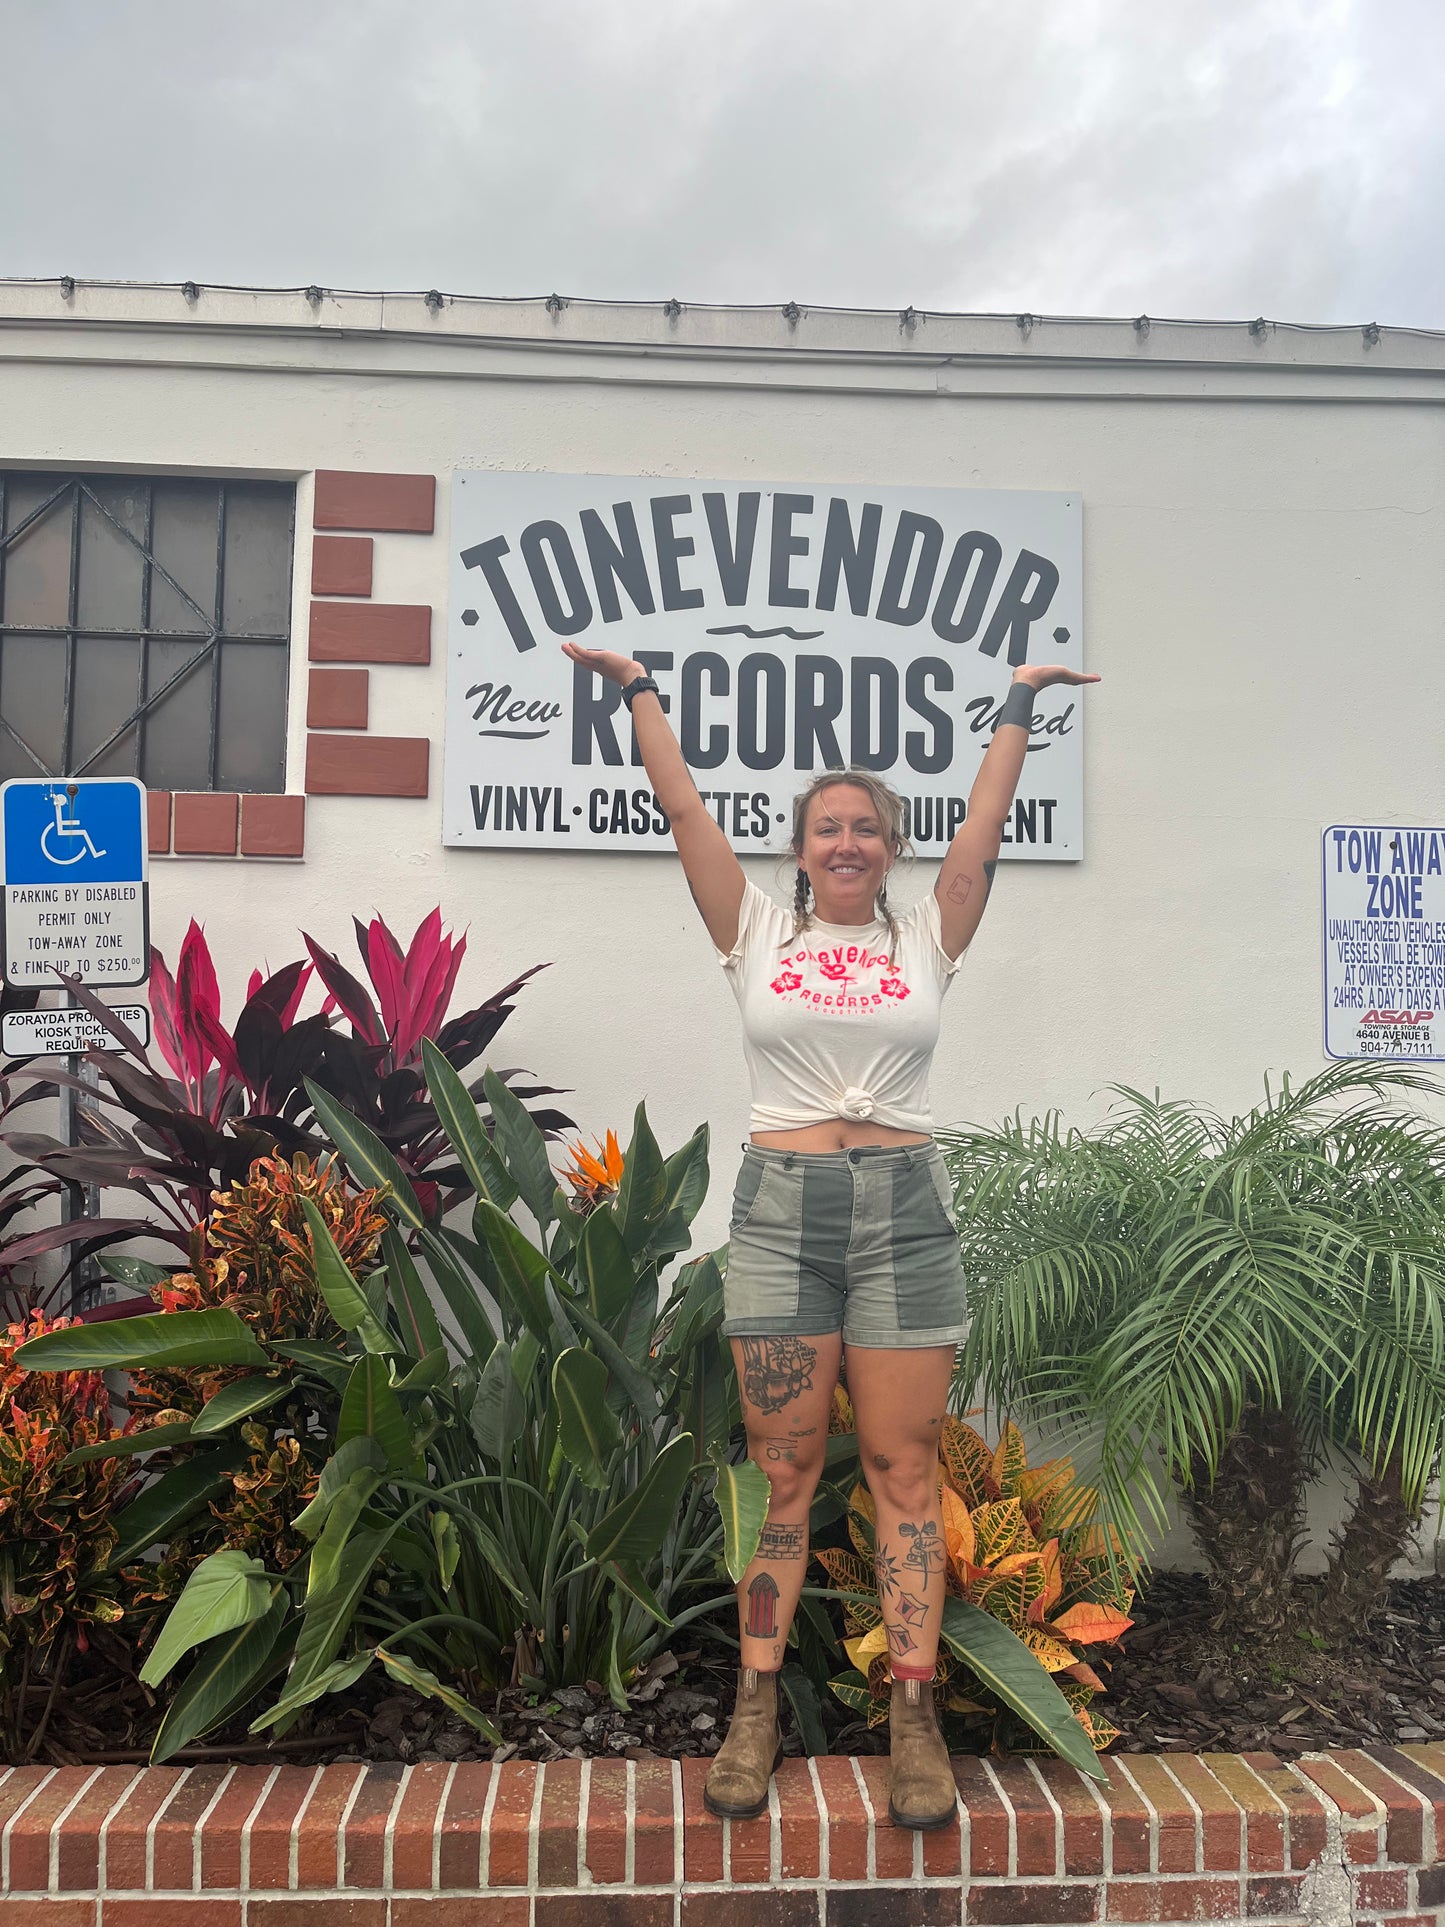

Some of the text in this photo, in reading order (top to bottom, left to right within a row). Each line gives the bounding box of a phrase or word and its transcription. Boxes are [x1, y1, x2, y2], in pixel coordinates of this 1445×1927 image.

[460, 491, 1060, 667] TONEVENDOR
[465, 682, 562, 724] New
[964, 695, 1075, 736] Ued
[469, 785, 570, 833] VINYL
[589, 788, 770, 838] CASSTES
[1333, 830, 1382, 874] TOW
[13, 887, 136, 903] PARKING BY DISABLED
[1366, 875, 1423, 919] ZONE
[39, 911, 111, 926] PERMIT ONLY
[1329, 920, 1401, 942] UNAUTHORIZED
[28, 935, 123, 950] TOW-AWAY ZONE
[1338, 942, 1380, 965] VESSELS
[1382, 943, 1405, 965] WILL
[1407, 944, 1419, 965] BE
[11, 962, 18, 974] &
[25, 961, 49, 974] FINE
[56, 960, 70, 973] UP
[77, 959, 90, 972] TO
[1345, 964, 1356, 986] AT
[1359, 965, 1403, 988] OWNER'S
[1334, 986, 1367, 1009] 24HRS.
[1369, 987, 1376, 1009] A
[1378, 988, 1396, 1009] DAY
[1399, 989, 1404, 1009] 7
[1407, 988, 1432, 1011] DAYS
[1434, 989, 1441, 1011] A
[9, 1009, 140, 1026] ZORAYDA PROTIES
[1360, 1010, 1434, 1025] ASAP
[35, 1026, 72, 1038] KIOSK
[1356, 1030, 1430, 1041] 4640 AVENUE B
[1360, 1041, 1433, 1054] 904-771-7111
